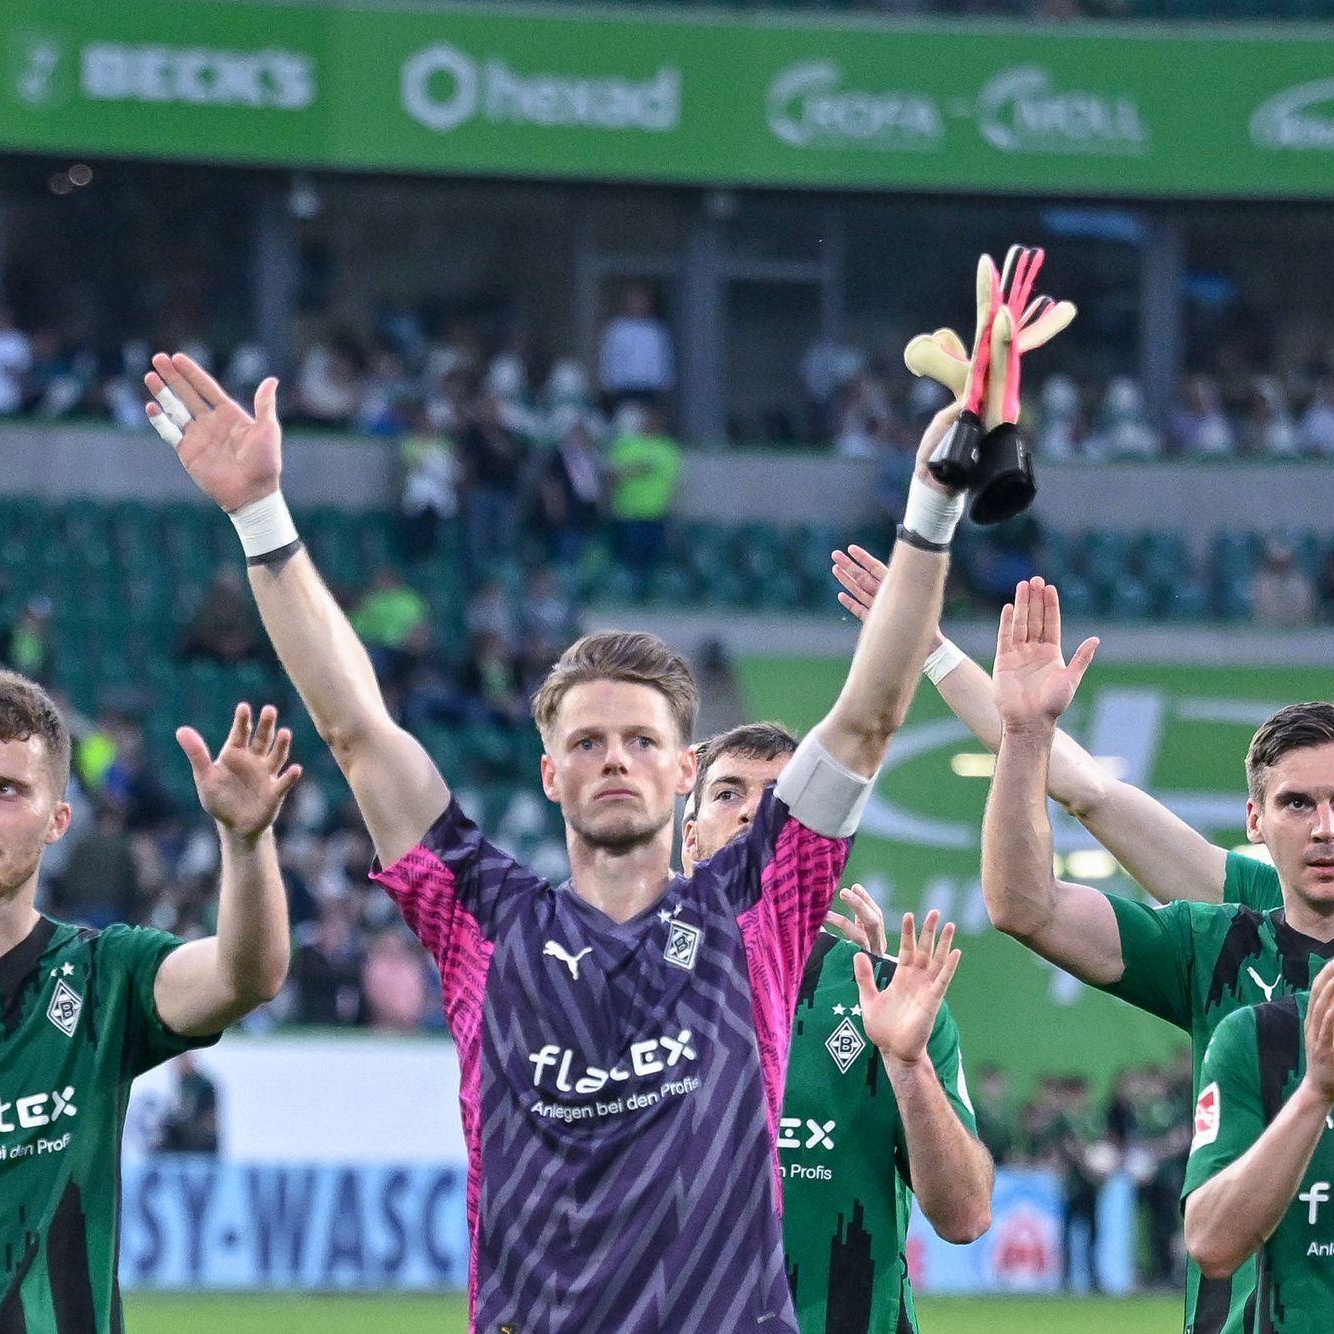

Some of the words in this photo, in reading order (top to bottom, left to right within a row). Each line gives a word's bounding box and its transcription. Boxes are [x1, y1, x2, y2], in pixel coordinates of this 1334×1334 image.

[484, 57, 680, 130] hexad
[531, 1101, 593, 1123] Anlegen
[597, 1098, 622, 1116] bei
[627, 1091, 658, 1111] den
[661, 1076, 702, 1098] Profis
[790, 1163, 832, 1180] Profis
